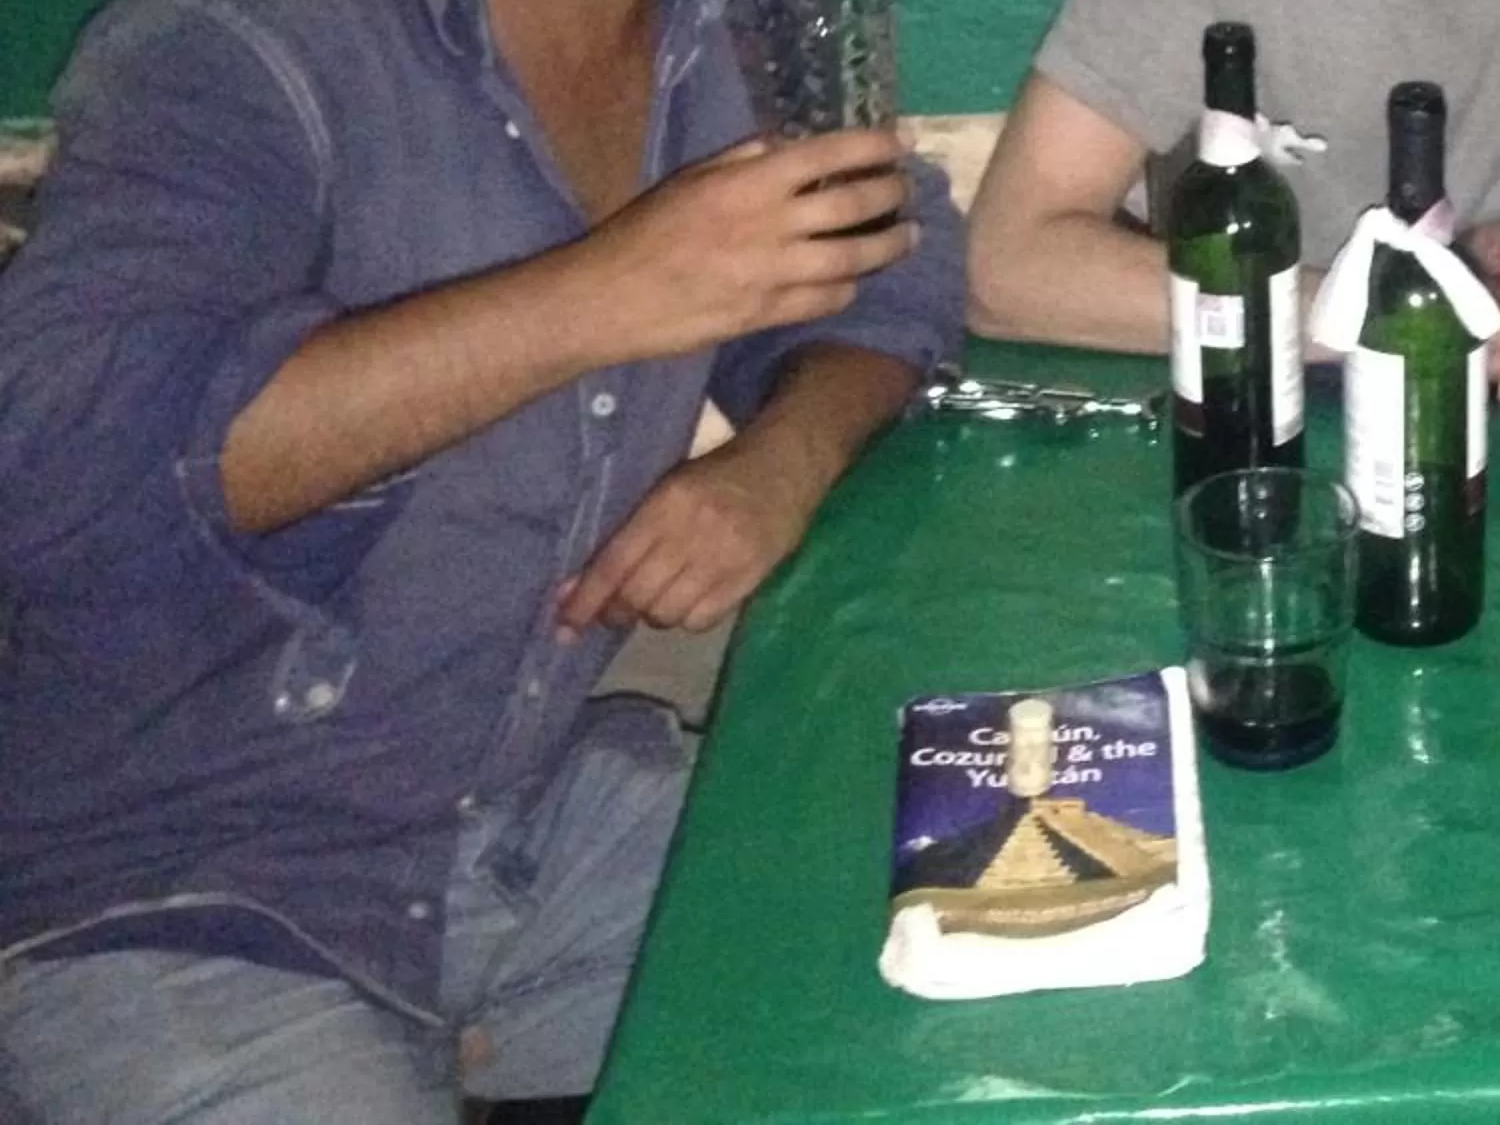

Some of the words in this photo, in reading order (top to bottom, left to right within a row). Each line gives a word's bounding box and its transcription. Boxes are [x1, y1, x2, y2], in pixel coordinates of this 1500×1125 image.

[968, 724, 1102, 746] Caún,
[910, 744, 1059, 767] Cozul
[1067, 744, 1093, 762] &
[1103, 740, 1157, 760] the
[965, 765, 1103, 789] Yután
